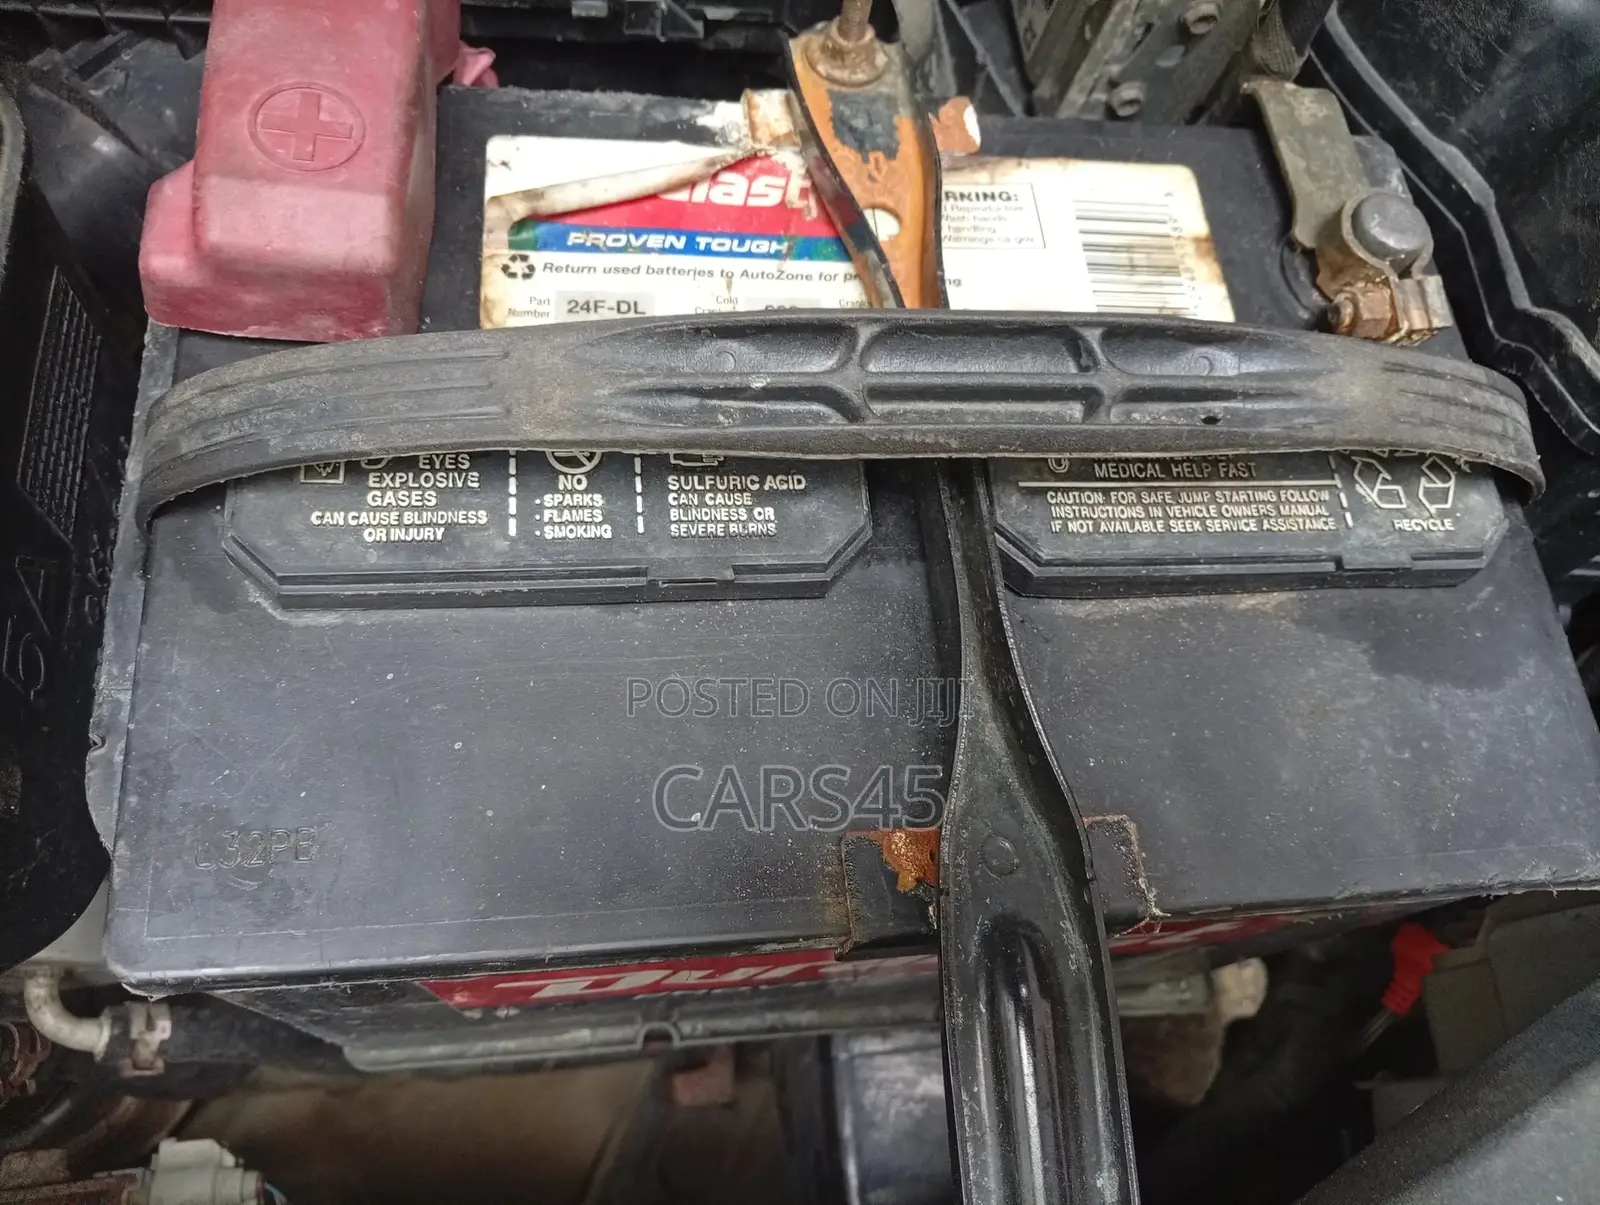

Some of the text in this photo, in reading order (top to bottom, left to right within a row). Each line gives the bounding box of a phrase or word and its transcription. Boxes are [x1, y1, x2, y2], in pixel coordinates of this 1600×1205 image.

[944, 190, 1018, 203] RNING:
[566, 231, 789, 254] PROVEN TOUGH
[543, 262, 597, 275] Return
[603, 263, 641, 275] used
[646, 264, 715, 279] batteries
[720, 268, 734, 279] to
[740, 268, 813, 281] AutoZone
[818, 271, 839, 281] for
[508, 296, 551, 319] Part Number
[566, 299, 647, 315] 24F-DL
[418, 453, 471, 470] EYES
[1093, 462, 1257, 479] MEDICAL HELP FAST
[368, 472, 481, 488] EXPLOSIVE
[558, 475, 588, 491] NO
[667, 475, 806, 491] SULFURIC ACID
[366, 490, 437, 507] GASES
[543, 493, 604, 508] SPARKS
[667, 492, 753, 506] CAN CAUSE
[1110, 491, 1137, 504] FOR
[1141, 491, 1172, 504] SAFE
[1177, 491, 1211, 503] JUMP
[1215, 490, 1277, 503] STARTING
[1280, 489, 1330, 503] FOLLOW
[310, 510, 488, 526] CAN CAUSE BLINDNESS
[543, 508, 604, 524] FLAMES
[669, 507, 776, 522] BLINDNESS OR
[1051, 504, 1330, 519] INSTRUCTIONS IN VEHICLE OWNERS MANUAL
[543, 524, 613, 539] SMOKING
[669, 522, 777, 538] SEVERE BURNS
[1050, 517, 1337, 533] IF NOT AVAILABLE SEEK SERVICE ASSISTANCE
[1393, 518, 1456, 532] RECYCLE
[363, 526, 445, 542] OR INJURY
